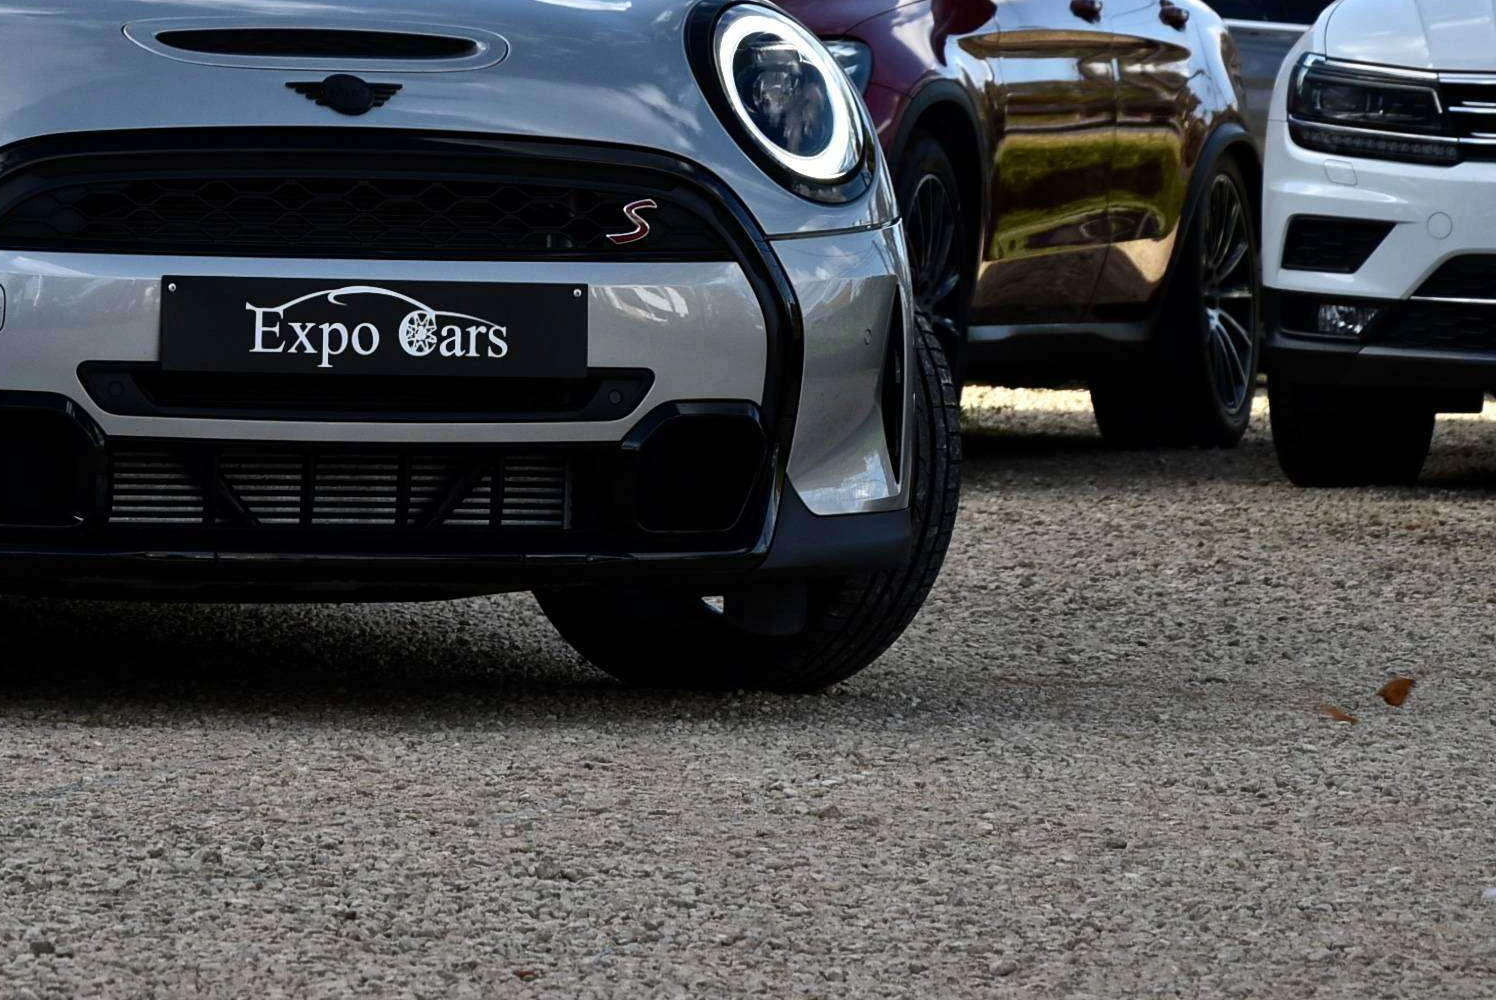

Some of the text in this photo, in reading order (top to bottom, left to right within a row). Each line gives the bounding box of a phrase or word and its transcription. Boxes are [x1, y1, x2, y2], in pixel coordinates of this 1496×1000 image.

[606, 198, 658, 245] S
[248, 306, 509, 368] Expo Cars
